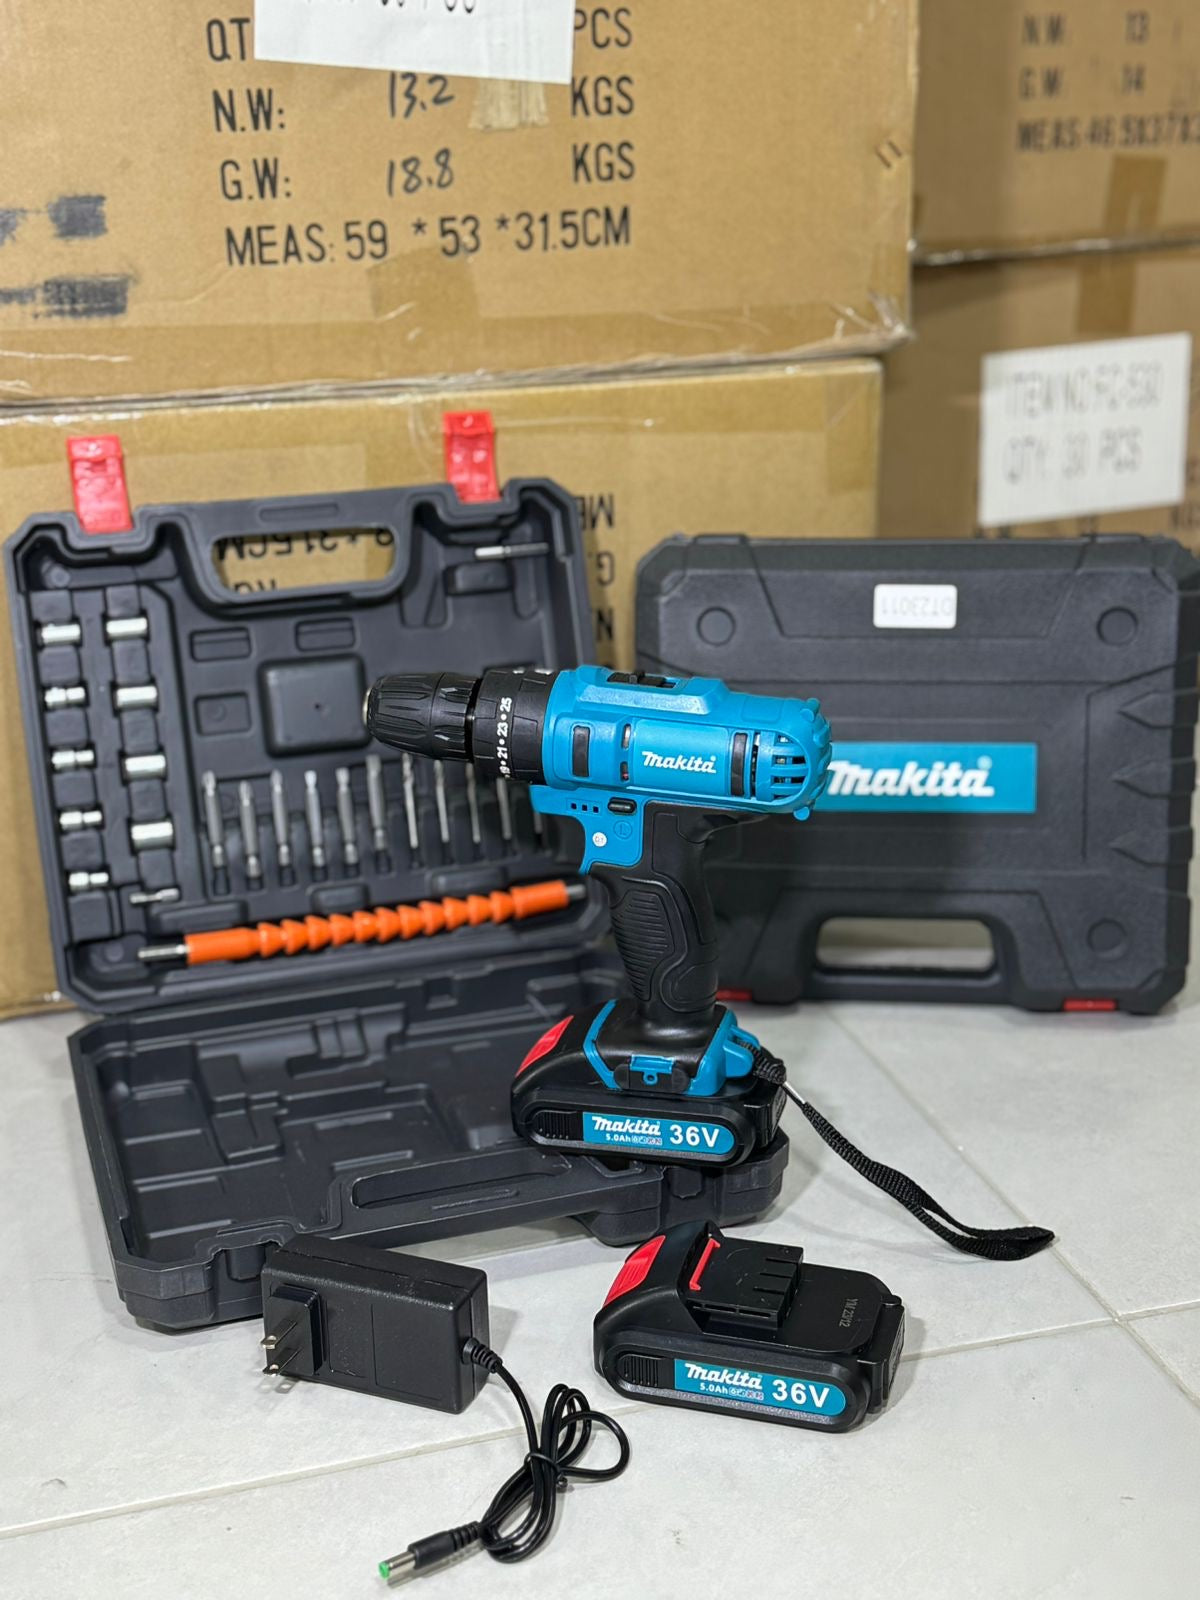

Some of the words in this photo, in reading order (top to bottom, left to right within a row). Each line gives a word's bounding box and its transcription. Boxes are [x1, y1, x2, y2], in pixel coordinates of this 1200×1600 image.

[212, 88, 286, 132] N.W:
[571, 77, 635, 117] KGS
[220, 156, 293, 201] G.W:
[387, 148, 455, 197] 18.8
[572, 142, 636, 183] KGS
[225, 223, 337, 267] MEAS:
[344, 220, 389, 261] 59
[500, 697, 512, 713] 25
[497, 721, 509, 738] 23
[497, 746, 508, 760] 21
[605, 1133, 631, 1143] 5.0Ah
[669, 1124, 720, 1148] 36V
[700, 1382, 728, 1395] 5.0Ah
[772, 1380, 830, 1408] 36V
